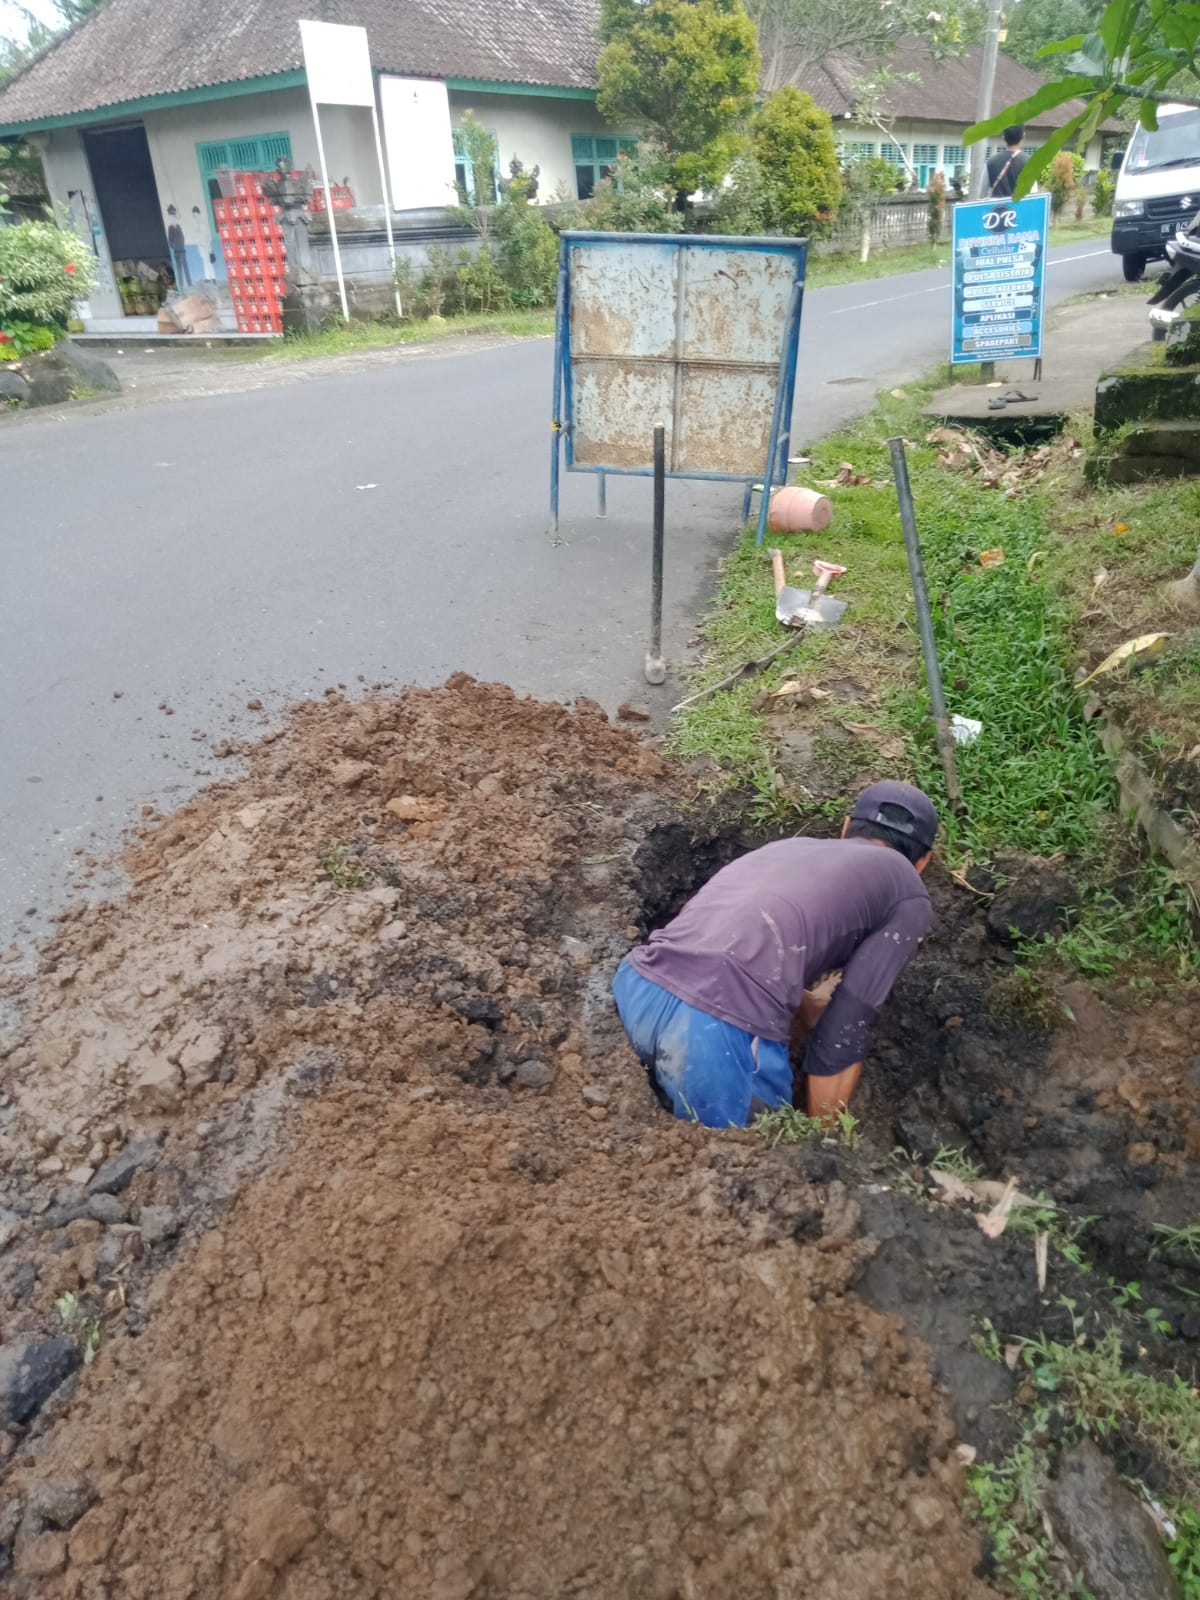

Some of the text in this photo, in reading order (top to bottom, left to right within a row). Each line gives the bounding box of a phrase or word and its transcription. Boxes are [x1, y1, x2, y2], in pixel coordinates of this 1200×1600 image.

[982, 210, 1018, 229] DR
[997, 254, 1024, 264] PULSA
[980, 312, 1015, 322] APLIKASI
